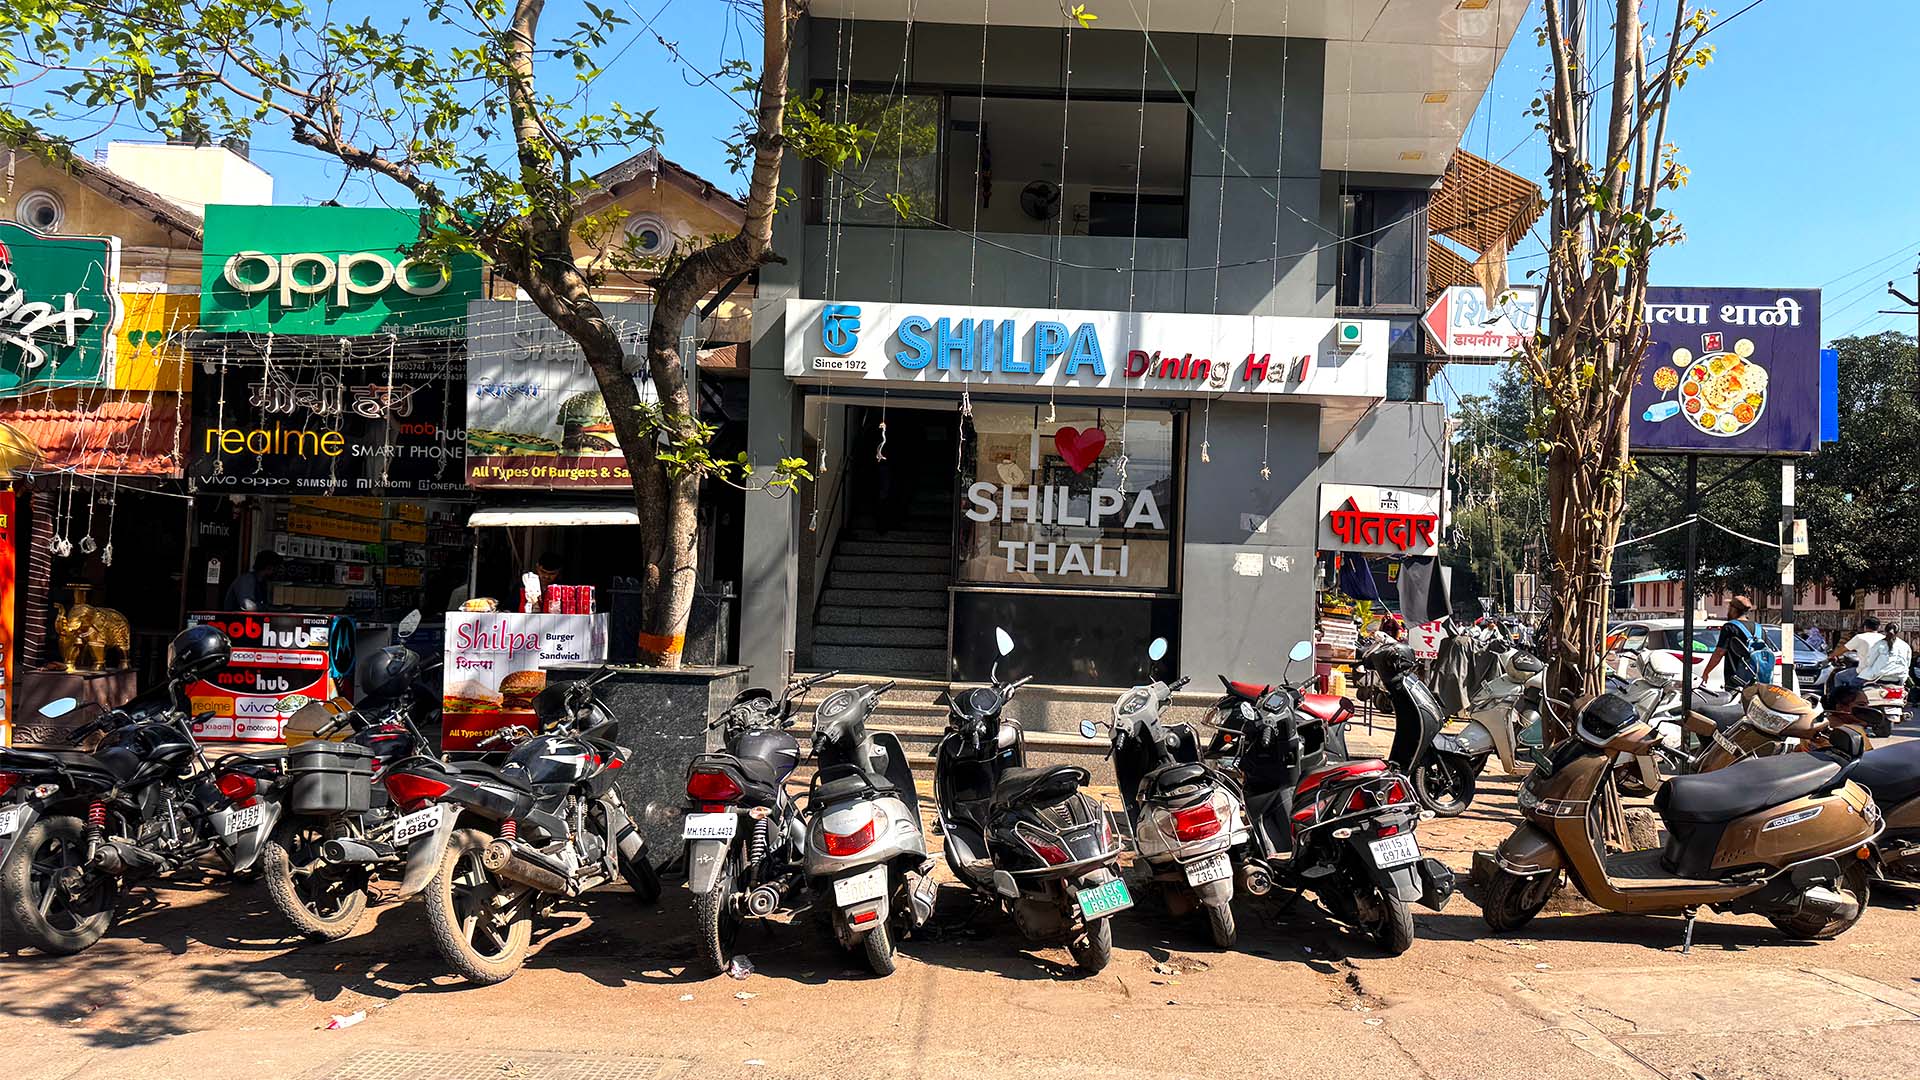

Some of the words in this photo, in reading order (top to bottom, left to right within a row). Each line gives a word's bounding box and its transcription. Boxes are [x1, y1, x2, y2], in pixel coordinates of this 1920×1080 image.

[224, 251, 451, 307] oppo
[1720, 298, 1802, 326] थाळी
[896, 315, 1106, 377] SHILPA
[814, 357, 842, 370] Since
[844, 359, 867, 371] 1972
[1124, 350, 1230, 388] Dining
[205, 420, 344, 456] realme
[352, 444, 404, 457] SMART
[411, 446, 463, 459] PHONE
[297, 477, 348, 488] SAMSUNG
[472, 467, 489, 478] All
[491, 467, 528, 481] Types
[532, 466, 547, 477] Of
[551, 466, 597, 481] Burgers
[601, 467, 611, 478] &
[965, 481, 1165, 530] SHILPA
[1330, 496, 1440, 550] पोतदार
[998, 540, 1129, 577] THALI
[456, 620, 541, 659] Shilpa
[546, 633, 575, 642] Burger
[456, 656, 494, 670] शिल्पा
[539, 652, 580, 660] Sandwich
[193, 701, 231, 711] realme
[240, 702, 275, 712] vivo
[449, 729, 460, 737] All
[462, 730, 483, 739] Types
[485, 729, 494, 737] Of
[398, 819, 439, 839] 8880
